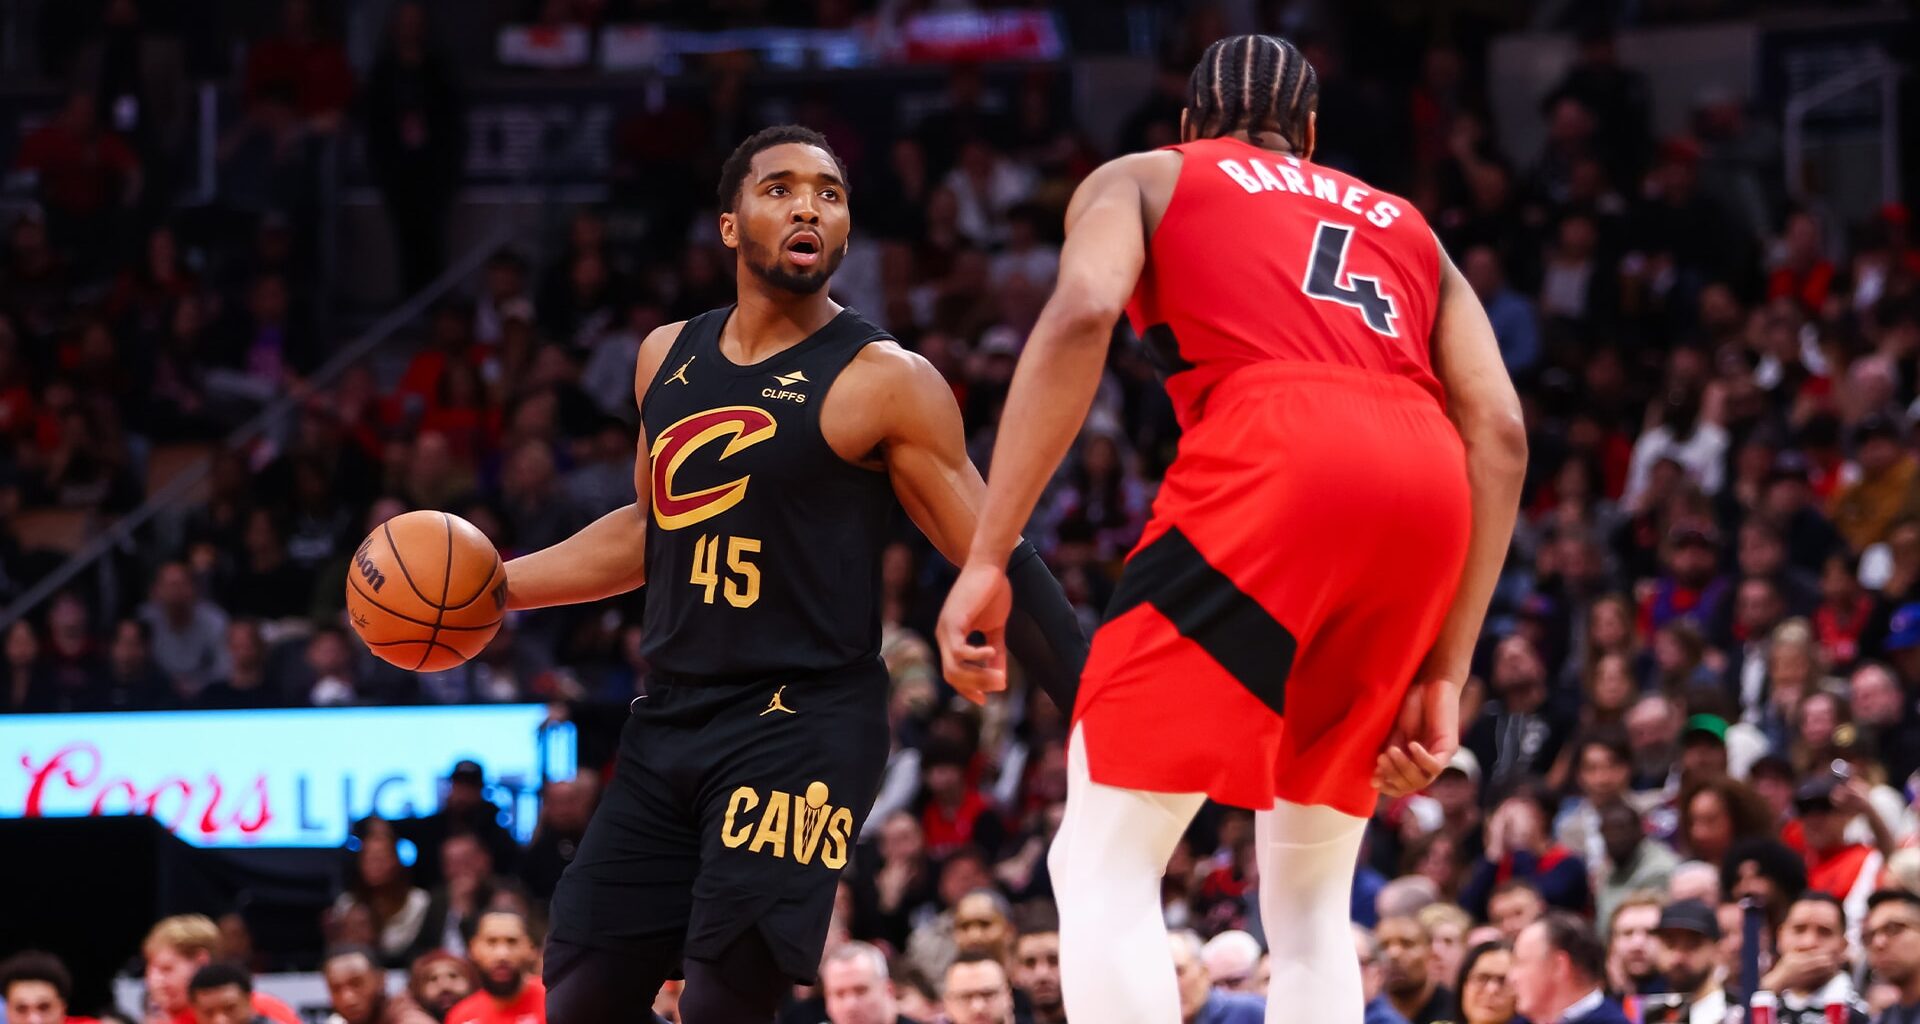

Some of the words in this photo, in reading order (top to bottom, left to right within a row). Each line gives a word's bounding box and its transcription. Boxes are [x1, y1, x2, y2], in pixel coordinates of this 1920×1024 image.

[1217, 158, 1400, 229] BARNES
[1301, 220, 1399, 338] 4
[761, 388, 806, 403] CLIFFS
[650, 405, 778, 531] C
[689, 533, 762, 609] 45
[19, 740, 273, 834] Coors
[721, 781, 853, 870] CAVS
